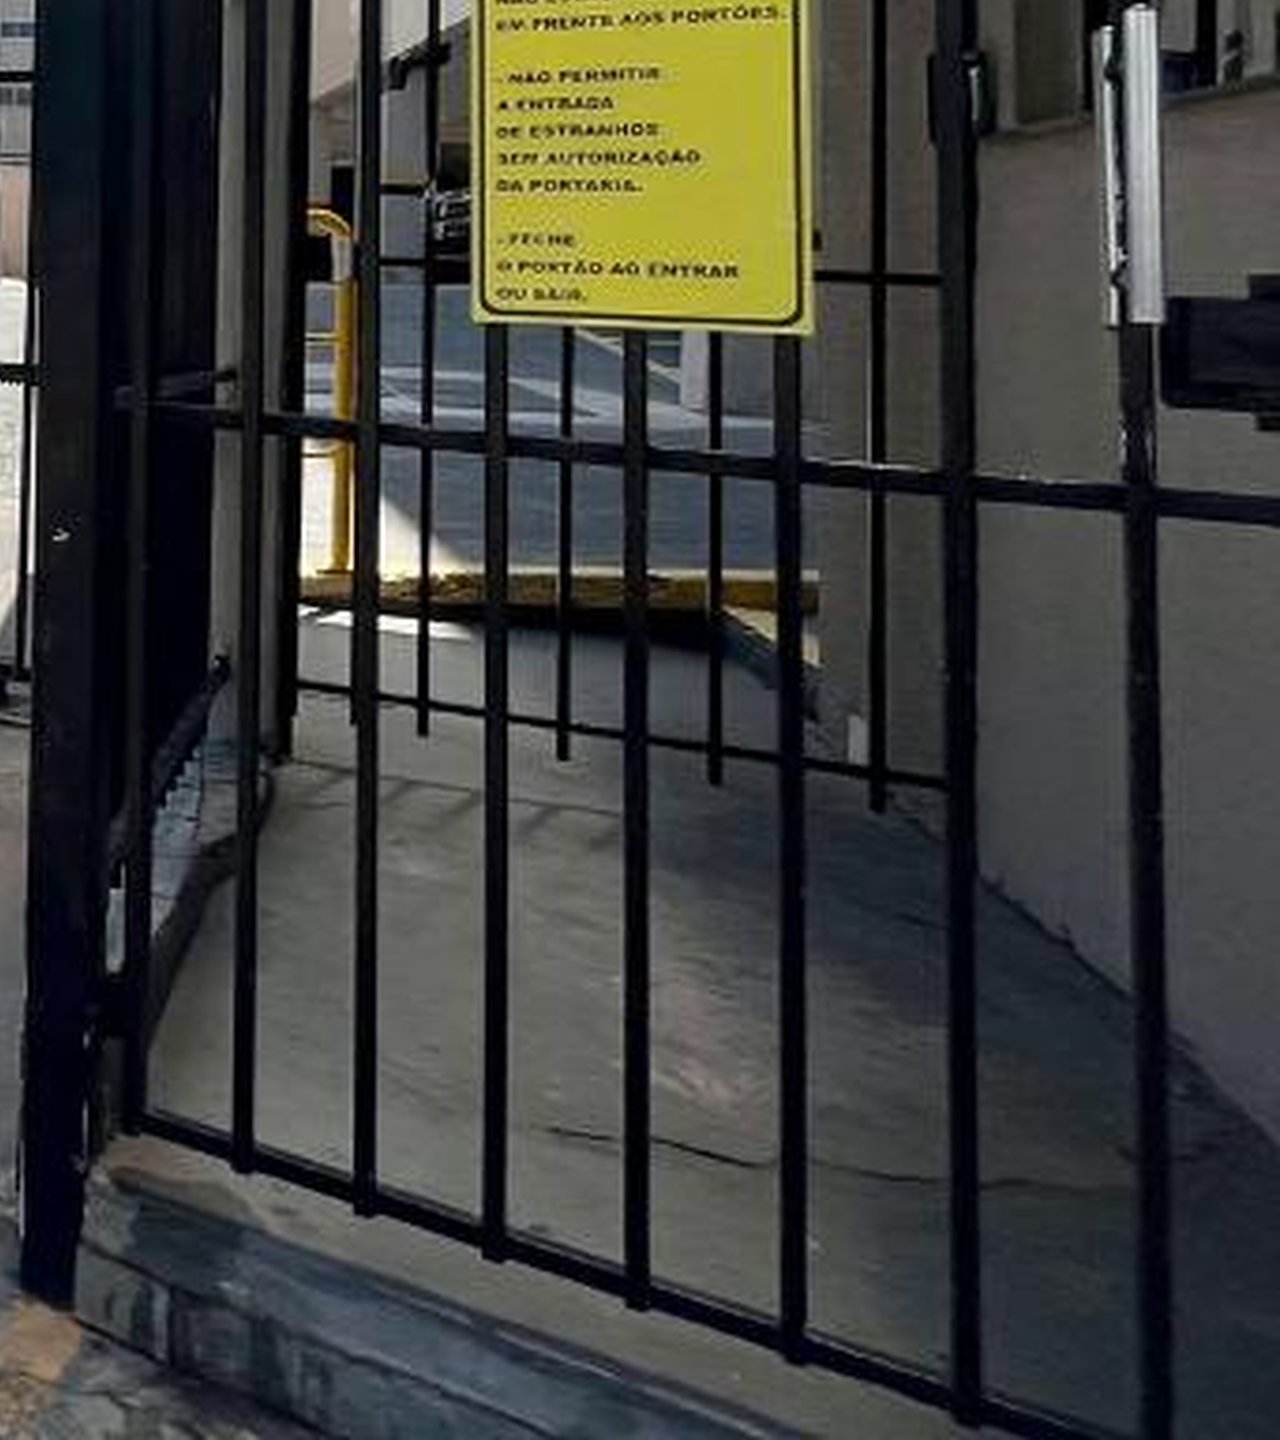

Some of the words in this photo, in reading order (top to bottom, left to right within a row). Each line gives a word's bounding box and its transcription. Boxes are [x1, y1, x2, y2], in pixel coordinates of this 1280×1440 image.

[532, 12, 614, 32] FRENTE
[619, 10, 665, 28] AOS
[529, 122, 660, 138] ESTRANHOS
[647, 262, 740, 279] ENTRAR
